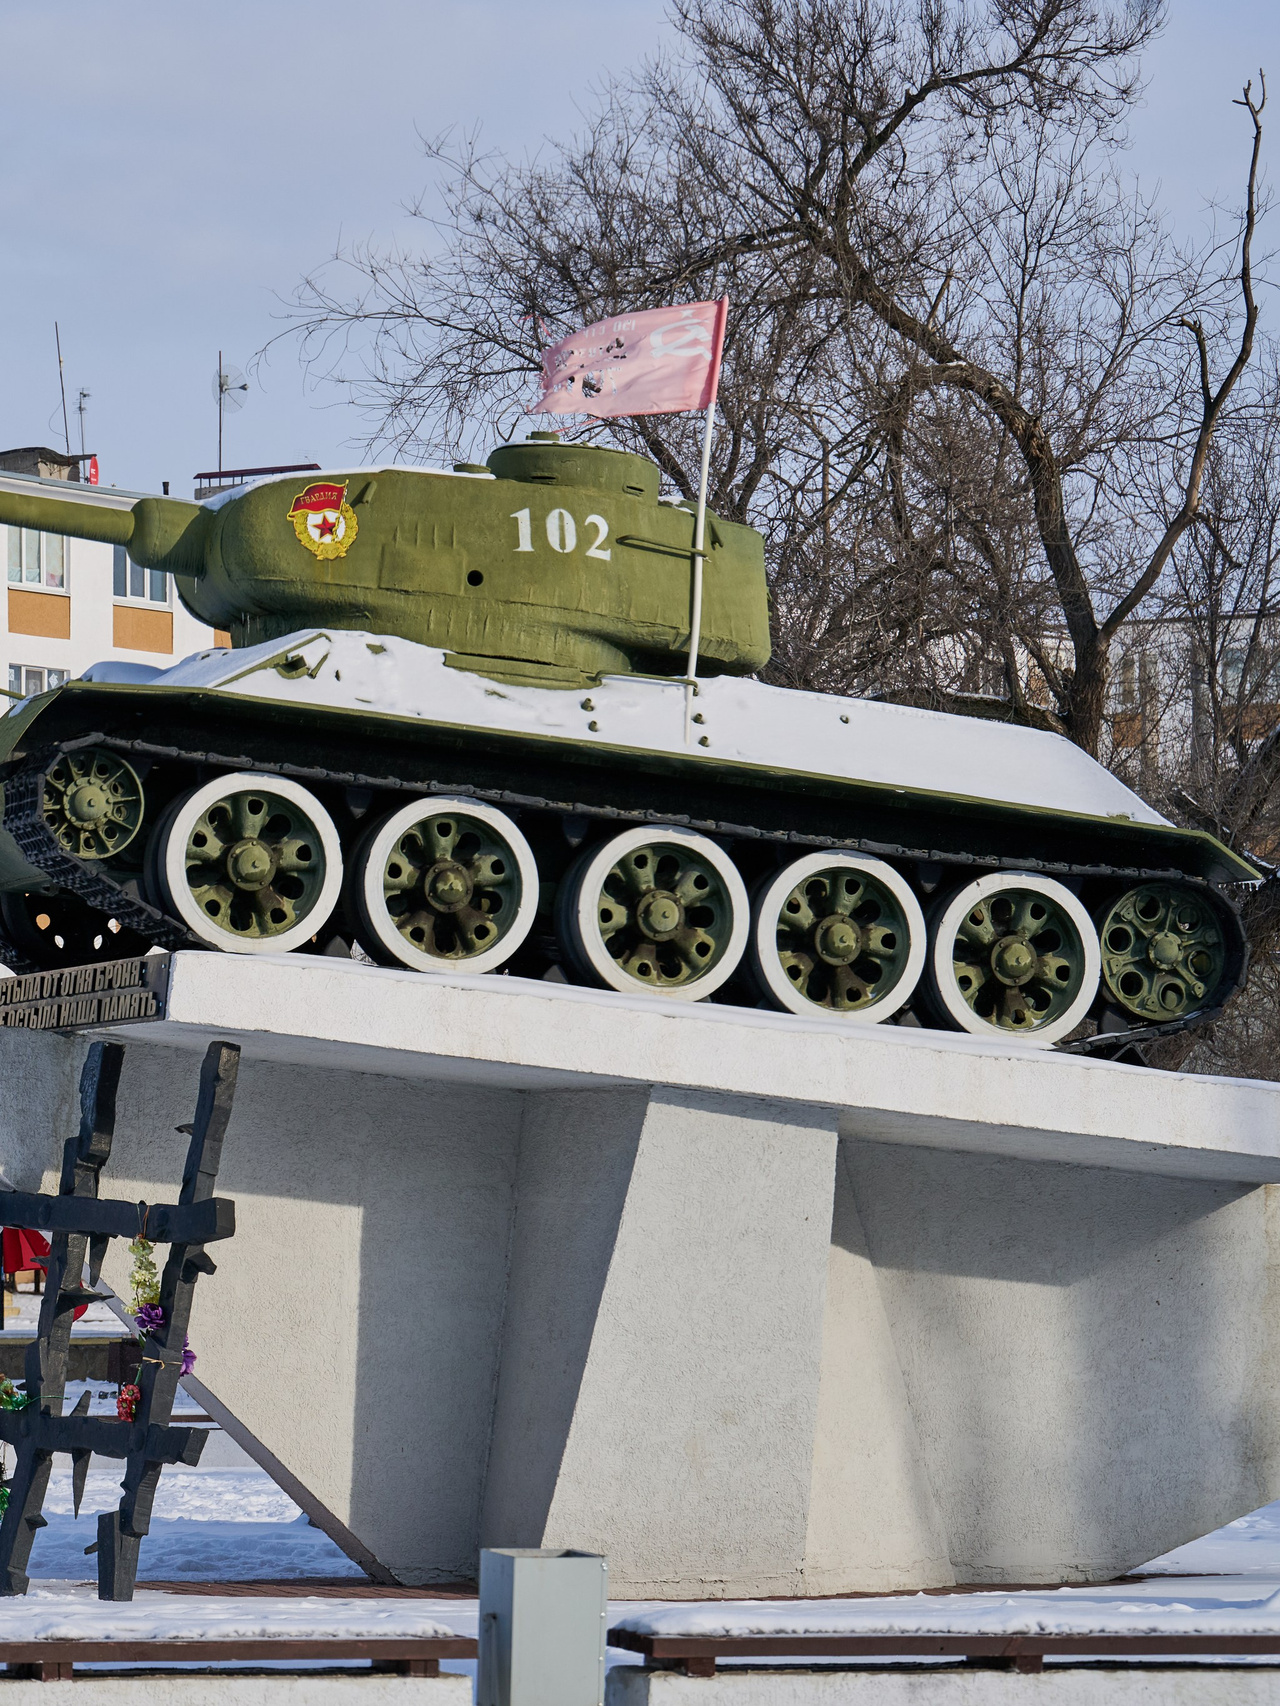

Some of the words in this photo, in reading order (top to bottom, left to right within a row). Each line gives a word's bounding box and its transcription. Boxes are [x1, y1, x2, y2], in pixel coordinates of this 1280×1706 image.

[300, 491, 338, 505] ГВАРДИЯ
[509, 507, 611, 561] 102
[43, 975, 60, 998] ОТ
[61, 969, 90, 995] ОГНЯ
[7, 1004, 57, 1029] ОСТЫЛА
[59, 998, 99, 1026] НАША
[100, 992, 157, 1018] ПАМЯТЬ
